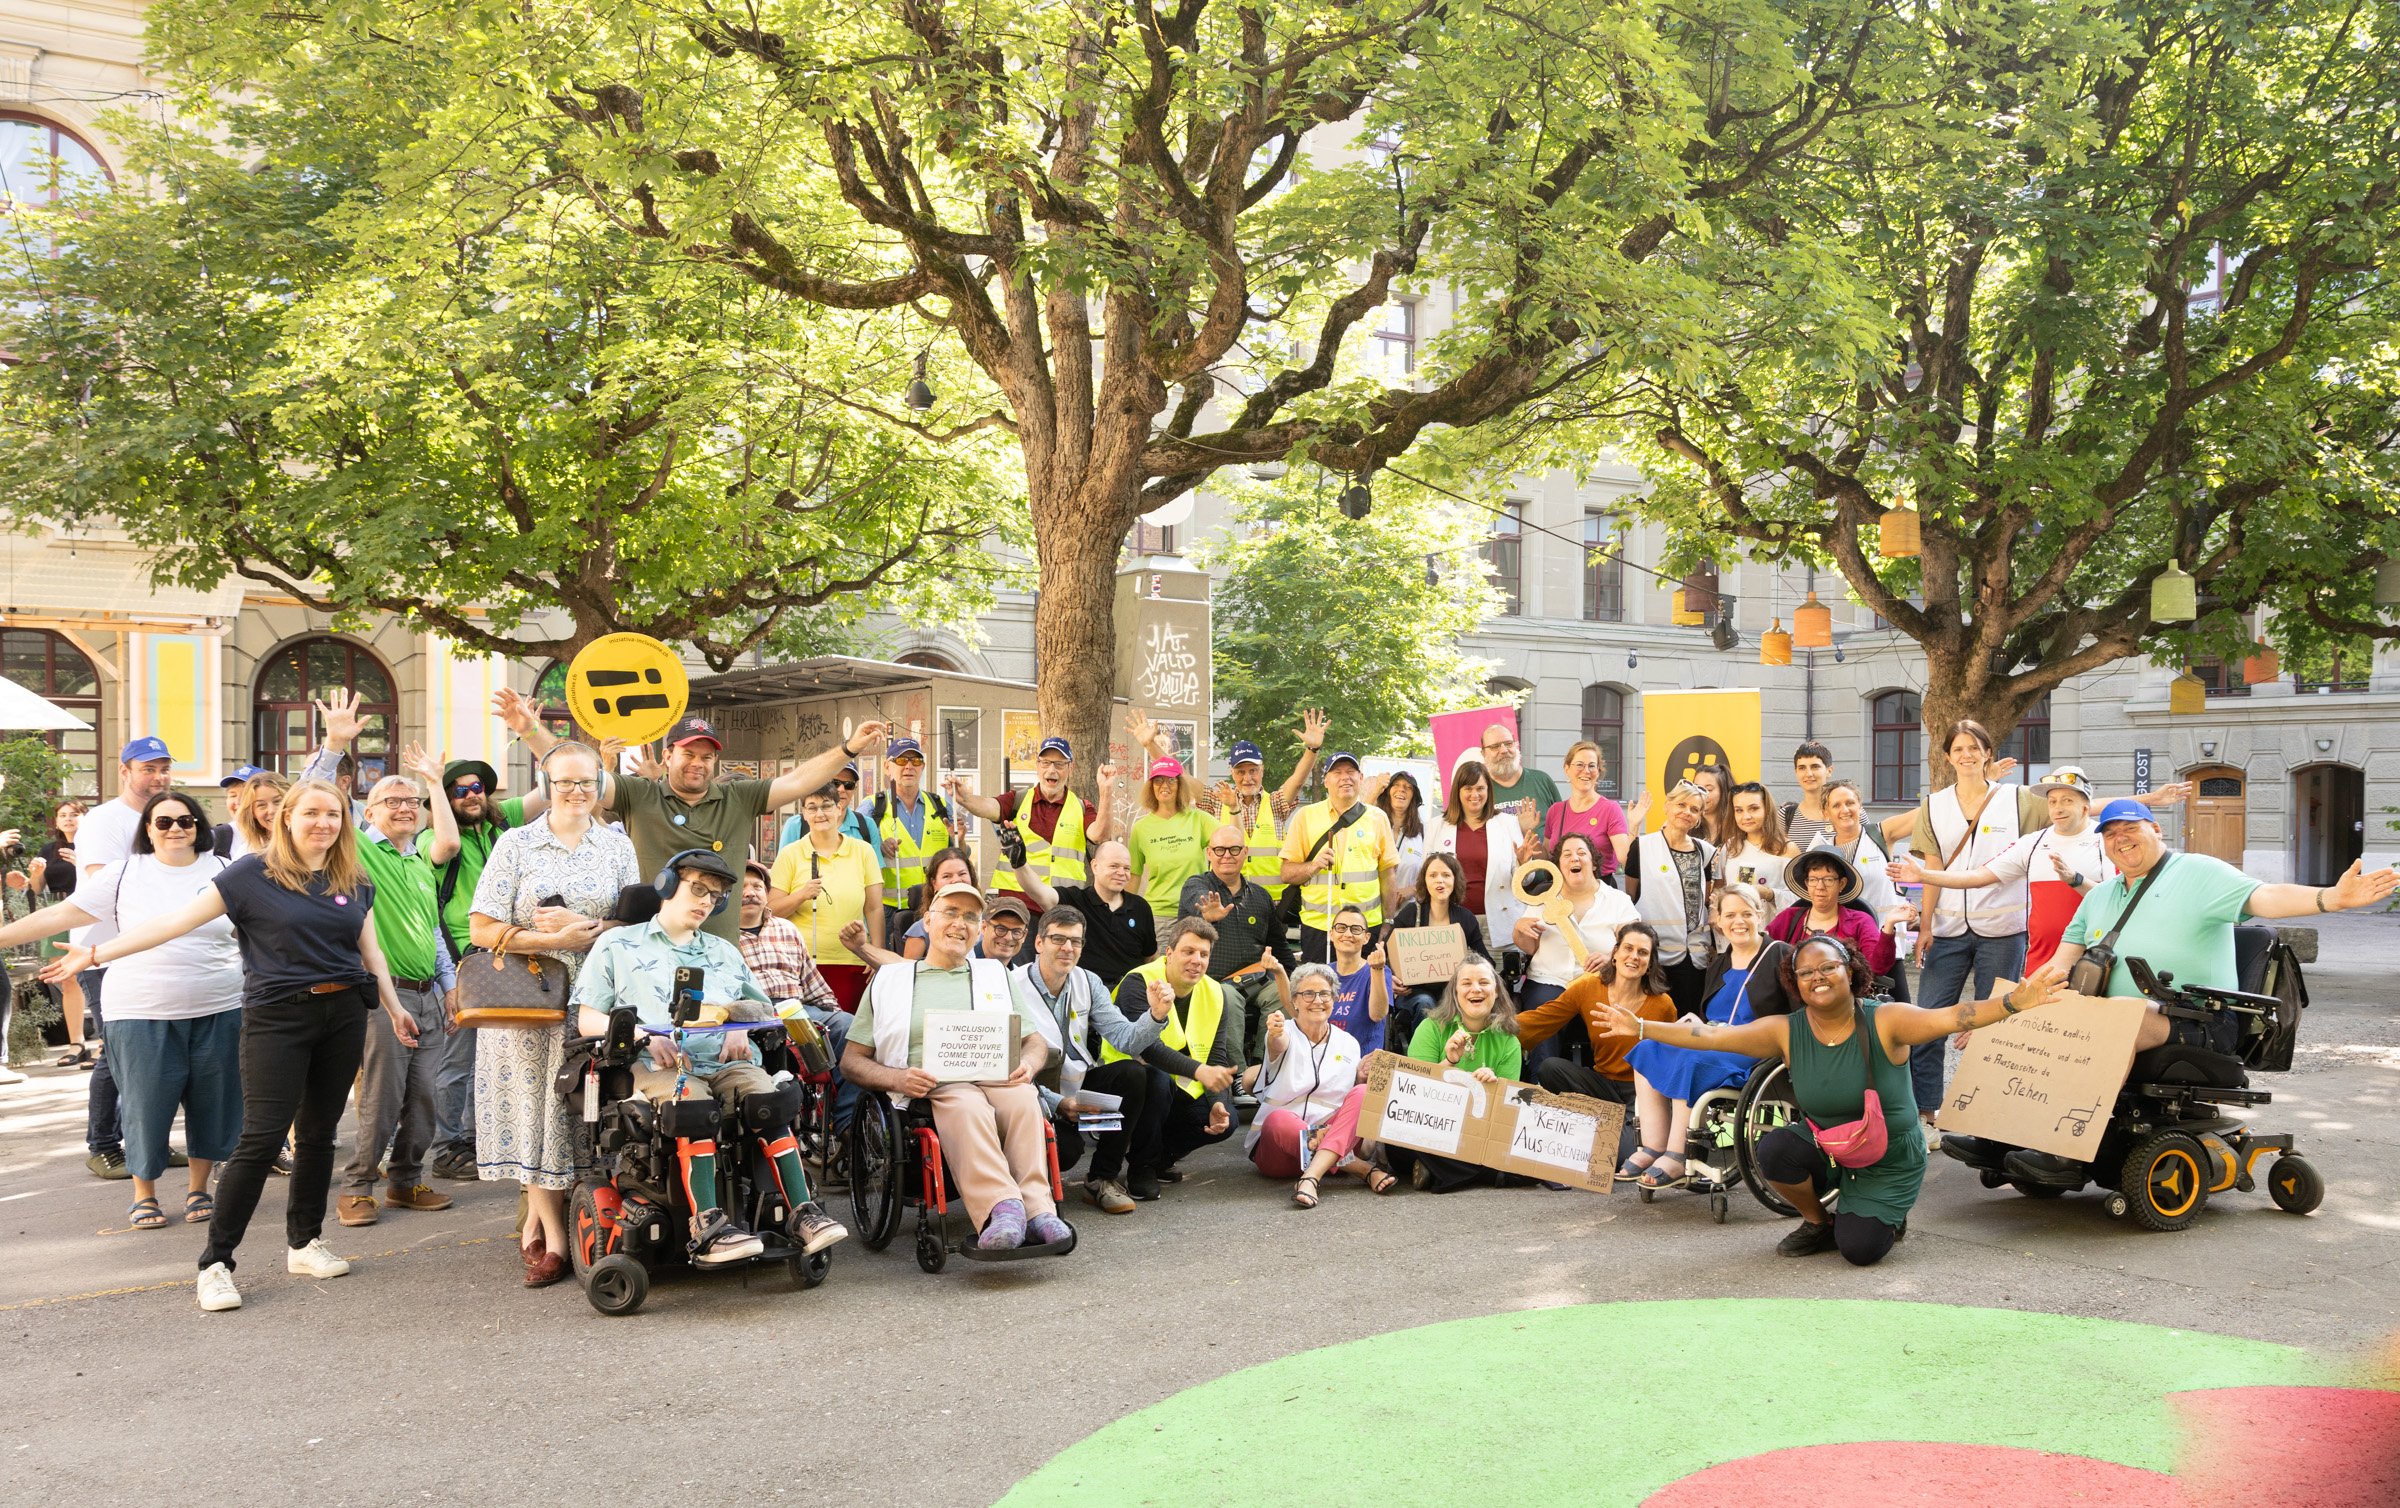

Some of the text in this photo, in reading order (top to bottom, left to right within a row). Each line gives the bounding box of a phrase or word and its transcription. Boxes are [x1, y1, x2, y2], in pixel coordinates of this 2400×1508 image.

[2137, 751, 2148, 777] OST
[1398, 929, 1455, 947] INKLUSION
[1335, 1005, 1350, 1016] AS
[946, 1025, 996, 1033] L'INCLUSION
[2021, 1016, 2059, 1034] möchten
[2063, 1029, 2091, 1042] endlich
[937, 1051, 968, 1059] COMME
[940, 1042, 1002, 1051] POUVOIR VIVRE
[1991, 1037, 2091, 1066] anerkannt werden und nicht
[943, 1060, 977, 1068] CHACUN
[1993, 1053, 2038, 1075] Aussenseiter
[2041, 1066, 2050, 1077] da
[1398, 1076, 1463, 1106] WIR WOLLEN
[2002, 1077, 2049, 1105] Stehen.
[1387, 1099, 1456, 1132] GEMEINSCHAFT
[1536, 1110, 1576, 1136] KEINE
